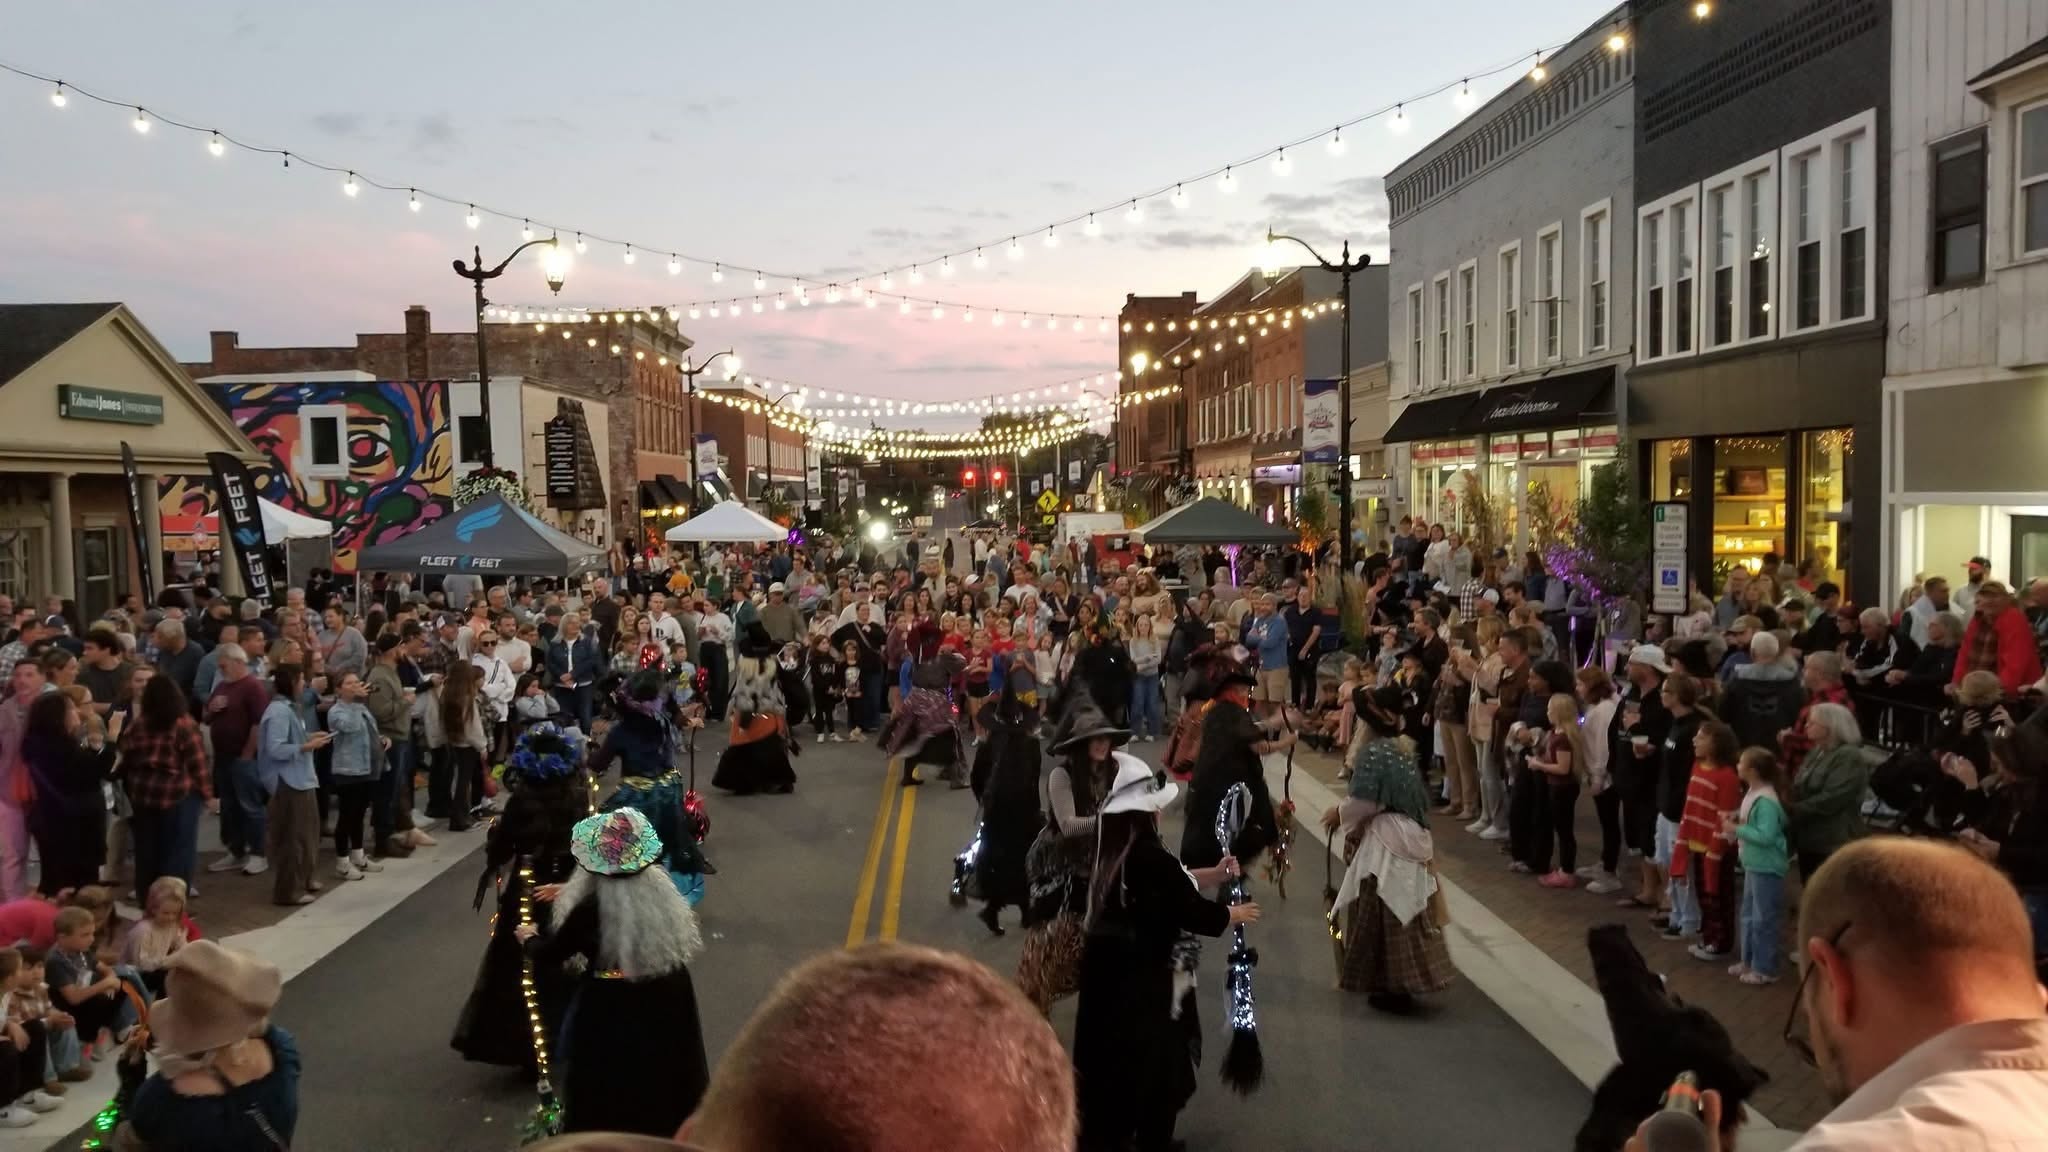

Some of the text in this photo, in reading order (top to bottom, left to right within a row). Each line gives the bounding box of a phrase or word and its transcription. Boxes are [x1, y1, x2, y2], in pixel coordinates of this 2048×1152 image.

[223, 472, 273, 611] FLEET FEET
[420, 556, 502, 569] FLEET FEET
